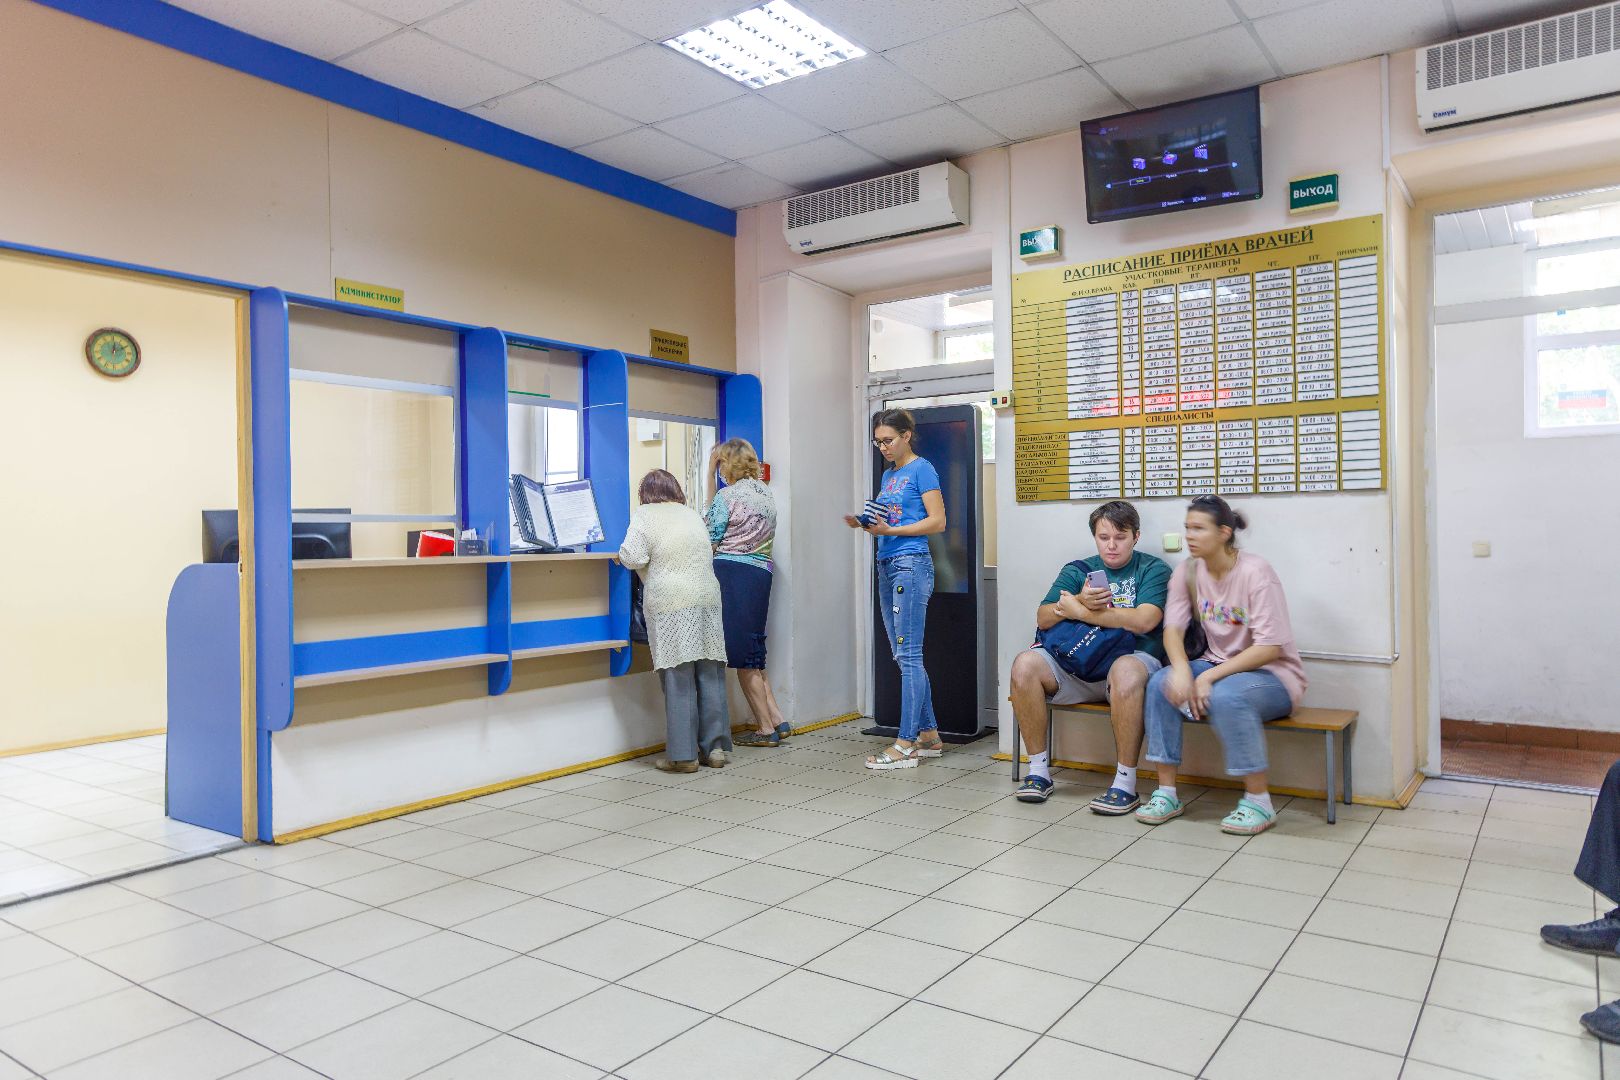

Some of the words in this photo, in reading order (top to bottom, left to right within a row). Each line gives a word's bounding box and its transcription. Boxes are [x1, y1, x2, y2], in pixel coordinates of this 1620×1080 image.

[1294, 184, 1334, 198] ВЫХОД
[1064, 253, 1166, 281] РАСПИСАНИЕ
[1170, 240, 1240, 264] ПРИЁМА
[1245, 226, 1314, 251] ВРАЧЕЙ
[1124, 266, 1182, 282] УЧАСТКОВЫЕ
[1187, 257, 1241, 273] ТЕРАПЕВТЫ
[340, 286, 401, 304] АДМИНИСТРАТОР
[1146, 412, 1214, 424] СПЕЦИАЛИСТЫ
